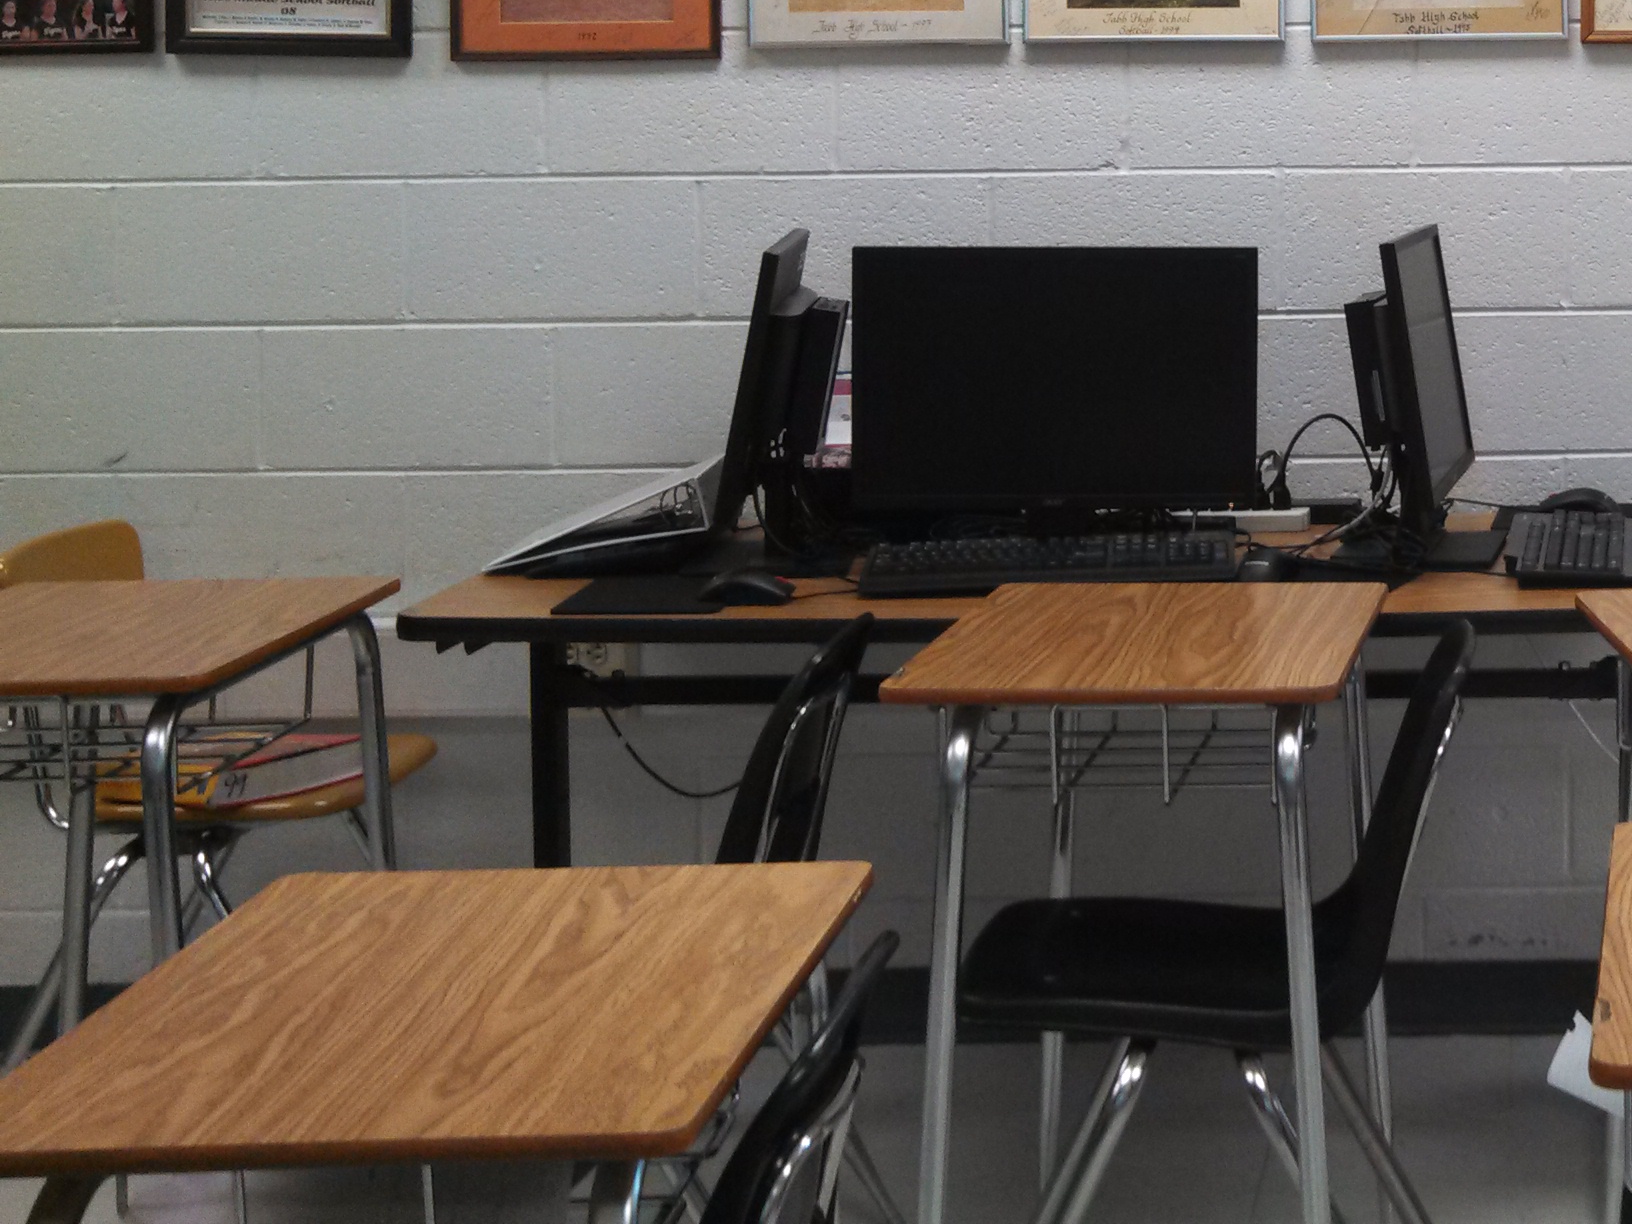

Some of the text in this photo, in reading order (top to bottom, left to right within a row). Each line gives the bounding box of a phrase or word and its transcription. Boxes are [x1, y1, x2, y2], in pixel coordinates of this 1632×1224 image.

[1102, 10, 1192, 28] Tabb High School
[1392, 10, 1480, 25] Tabb High School
